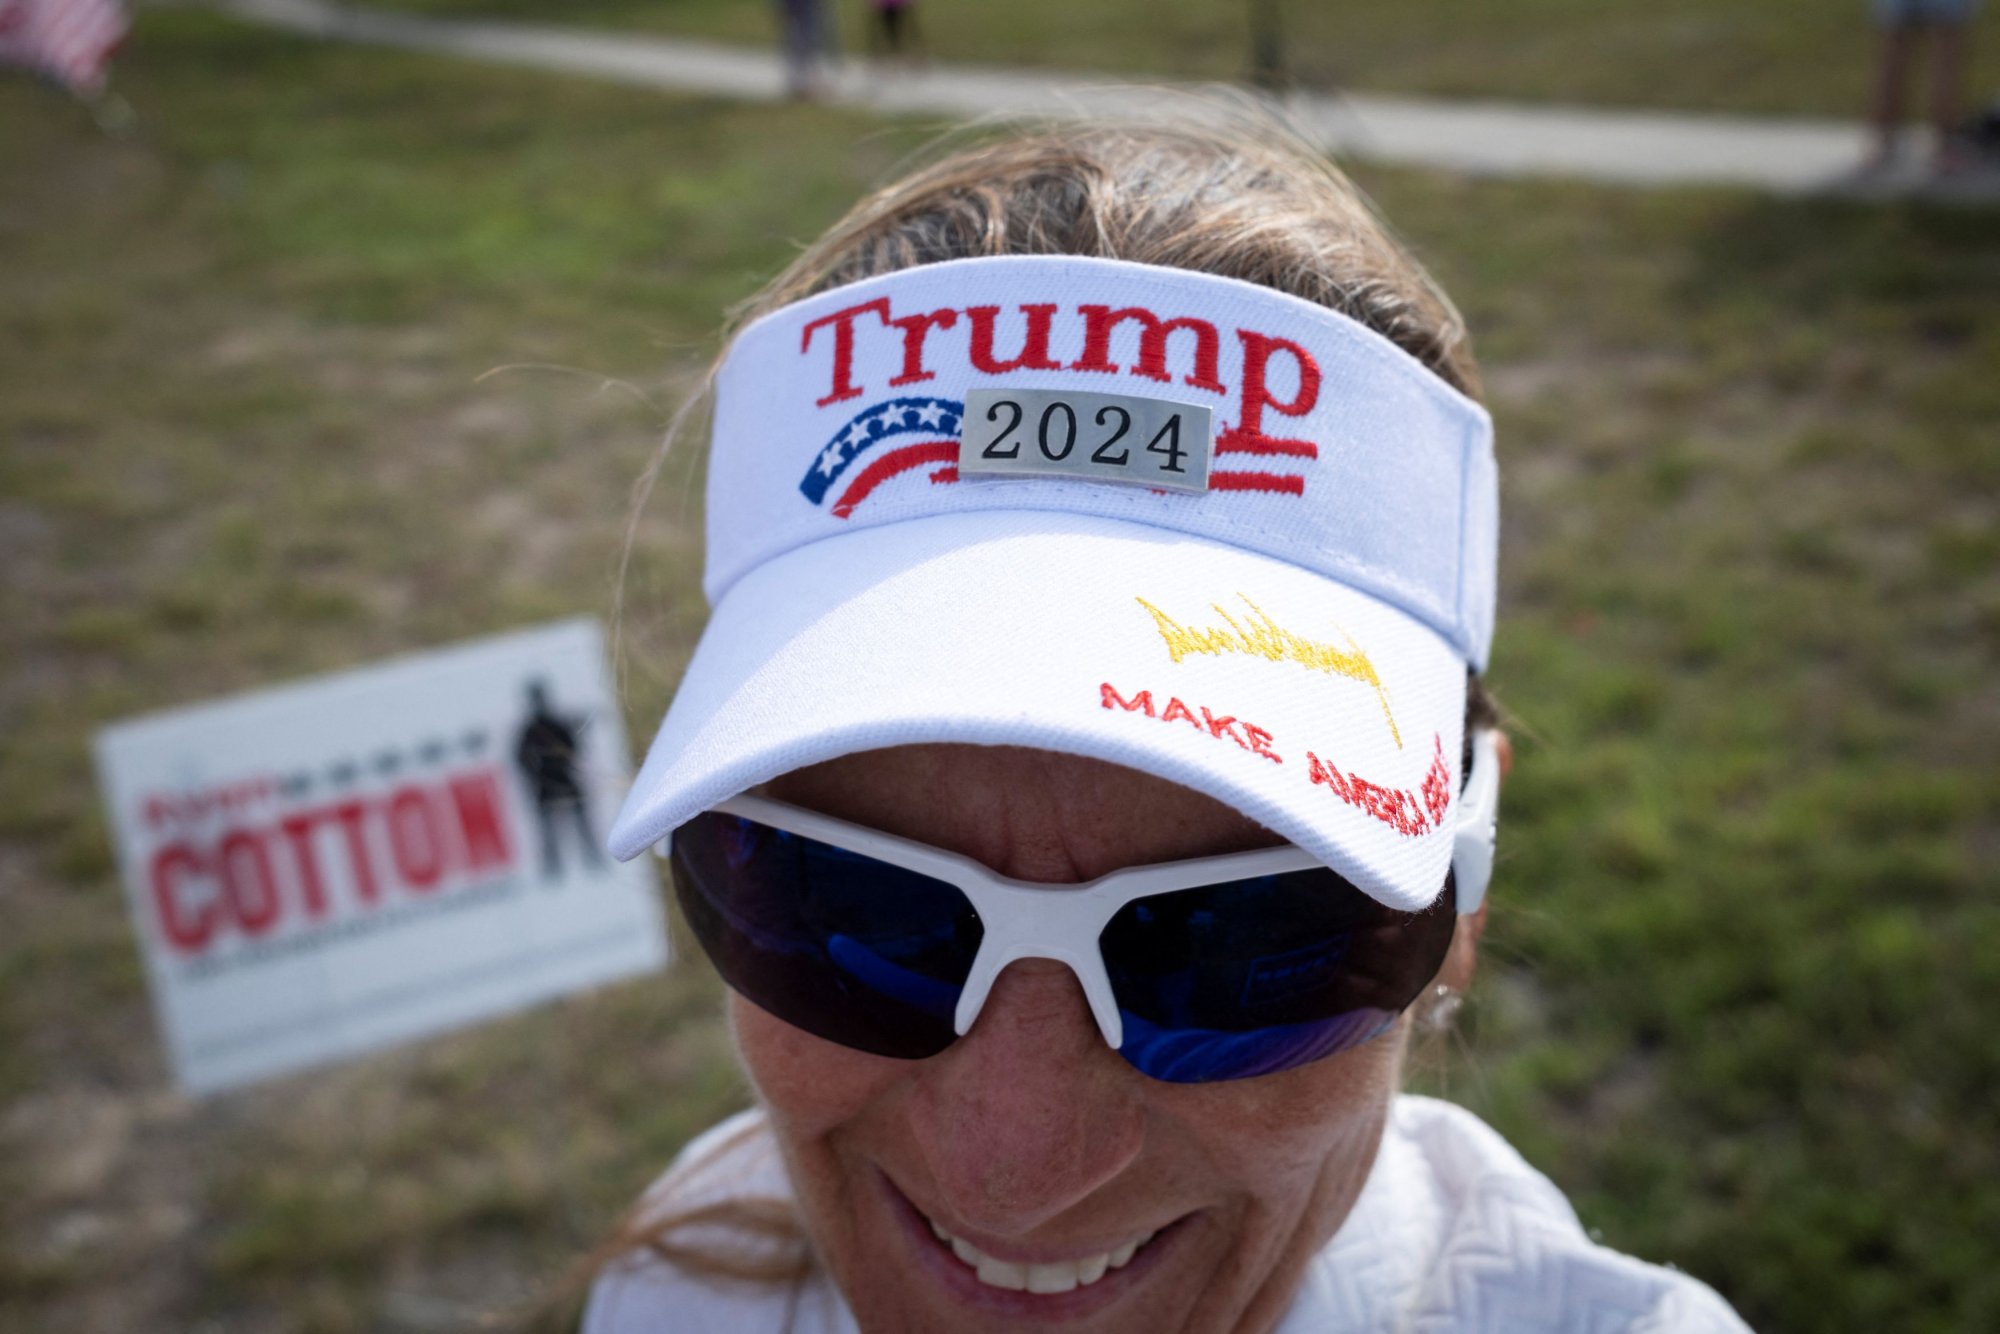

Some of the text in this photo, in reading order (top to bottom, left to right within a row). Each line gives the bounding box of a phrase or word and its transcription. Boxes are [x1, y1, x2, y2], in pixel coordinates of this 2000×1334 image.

[800, 296, 1322, 438] Trump
[981, 400, 1189, 473] 2024
[1100, 682, 1283, 765] MAKE
